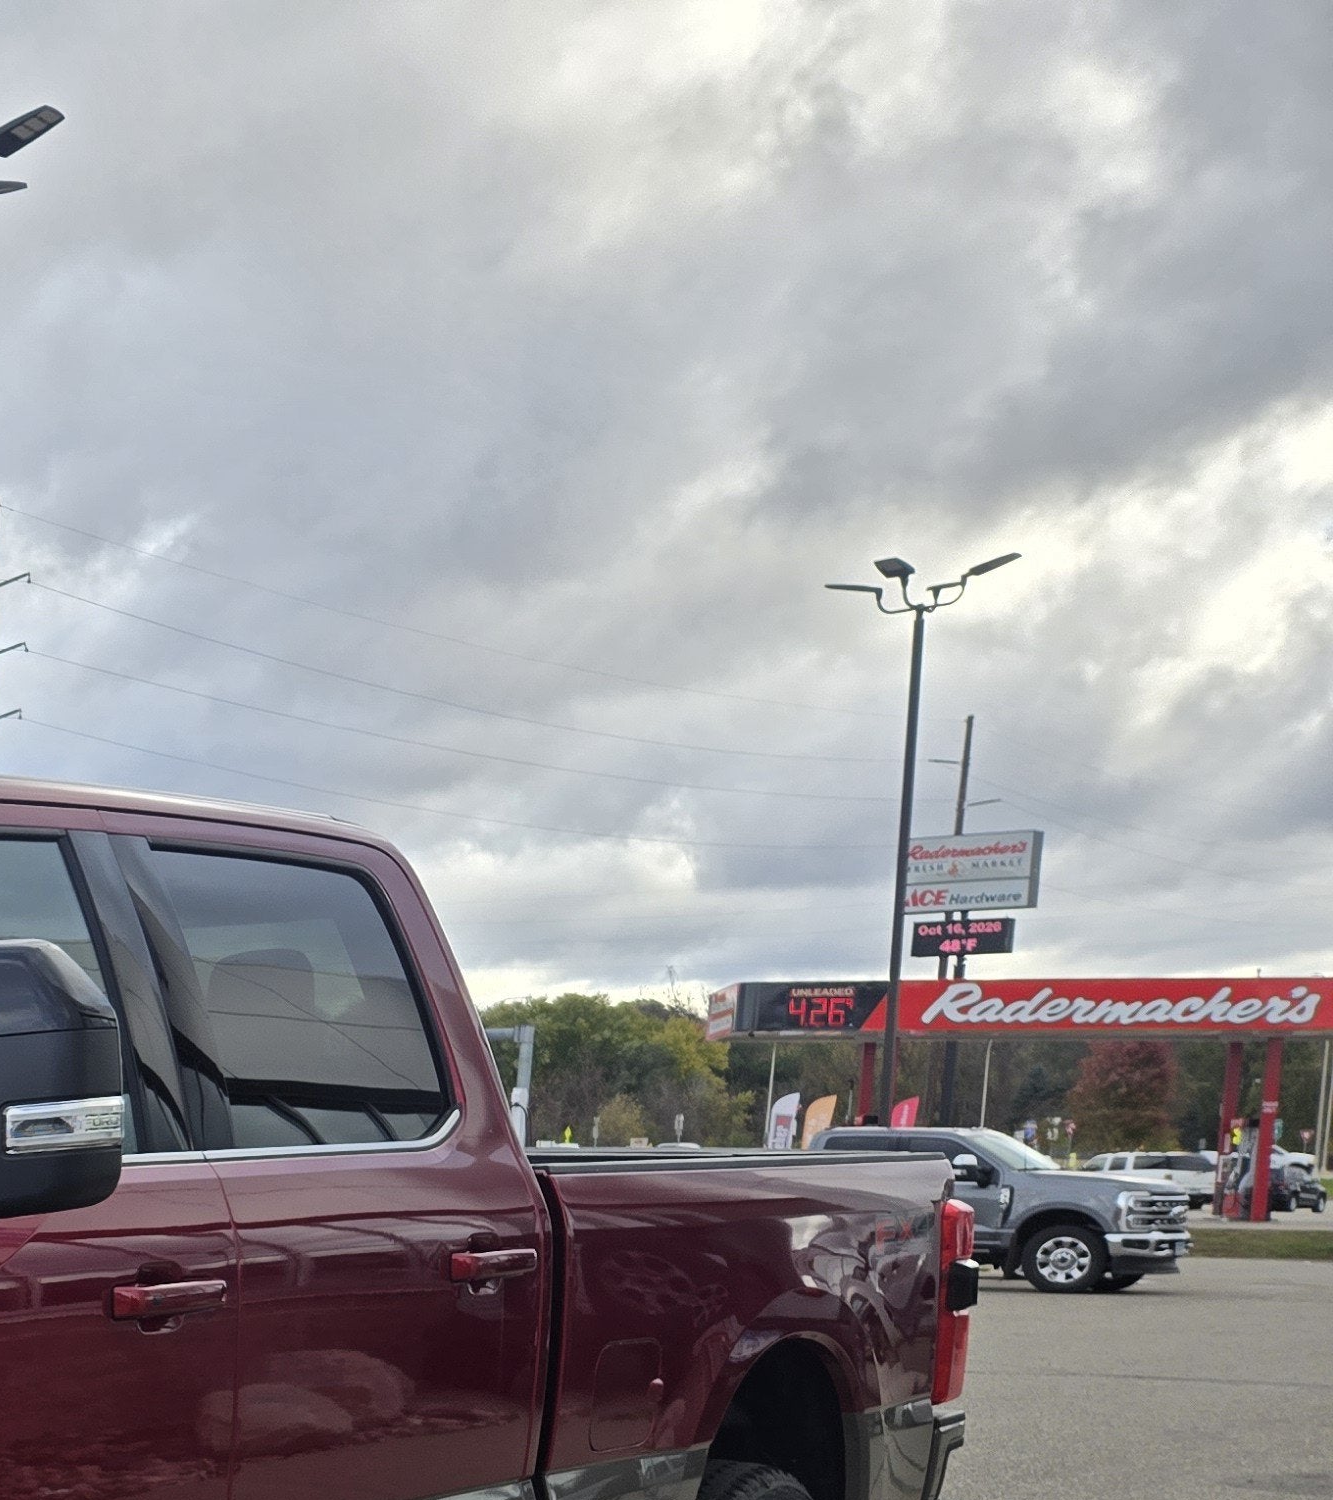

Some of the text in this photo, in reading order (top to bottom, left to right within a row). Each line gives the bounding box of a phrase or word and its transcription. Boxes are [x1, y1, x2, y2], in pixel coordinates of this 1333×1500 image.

[907, 863, 944, 873] RESH
[905, 888, 1022, 907] ACE Hardware
[917, 925, 942, 936] Oct
[791, 987, 854, 997] UNLEADED
[921, 983, 1321, 1025] Radermacher's
